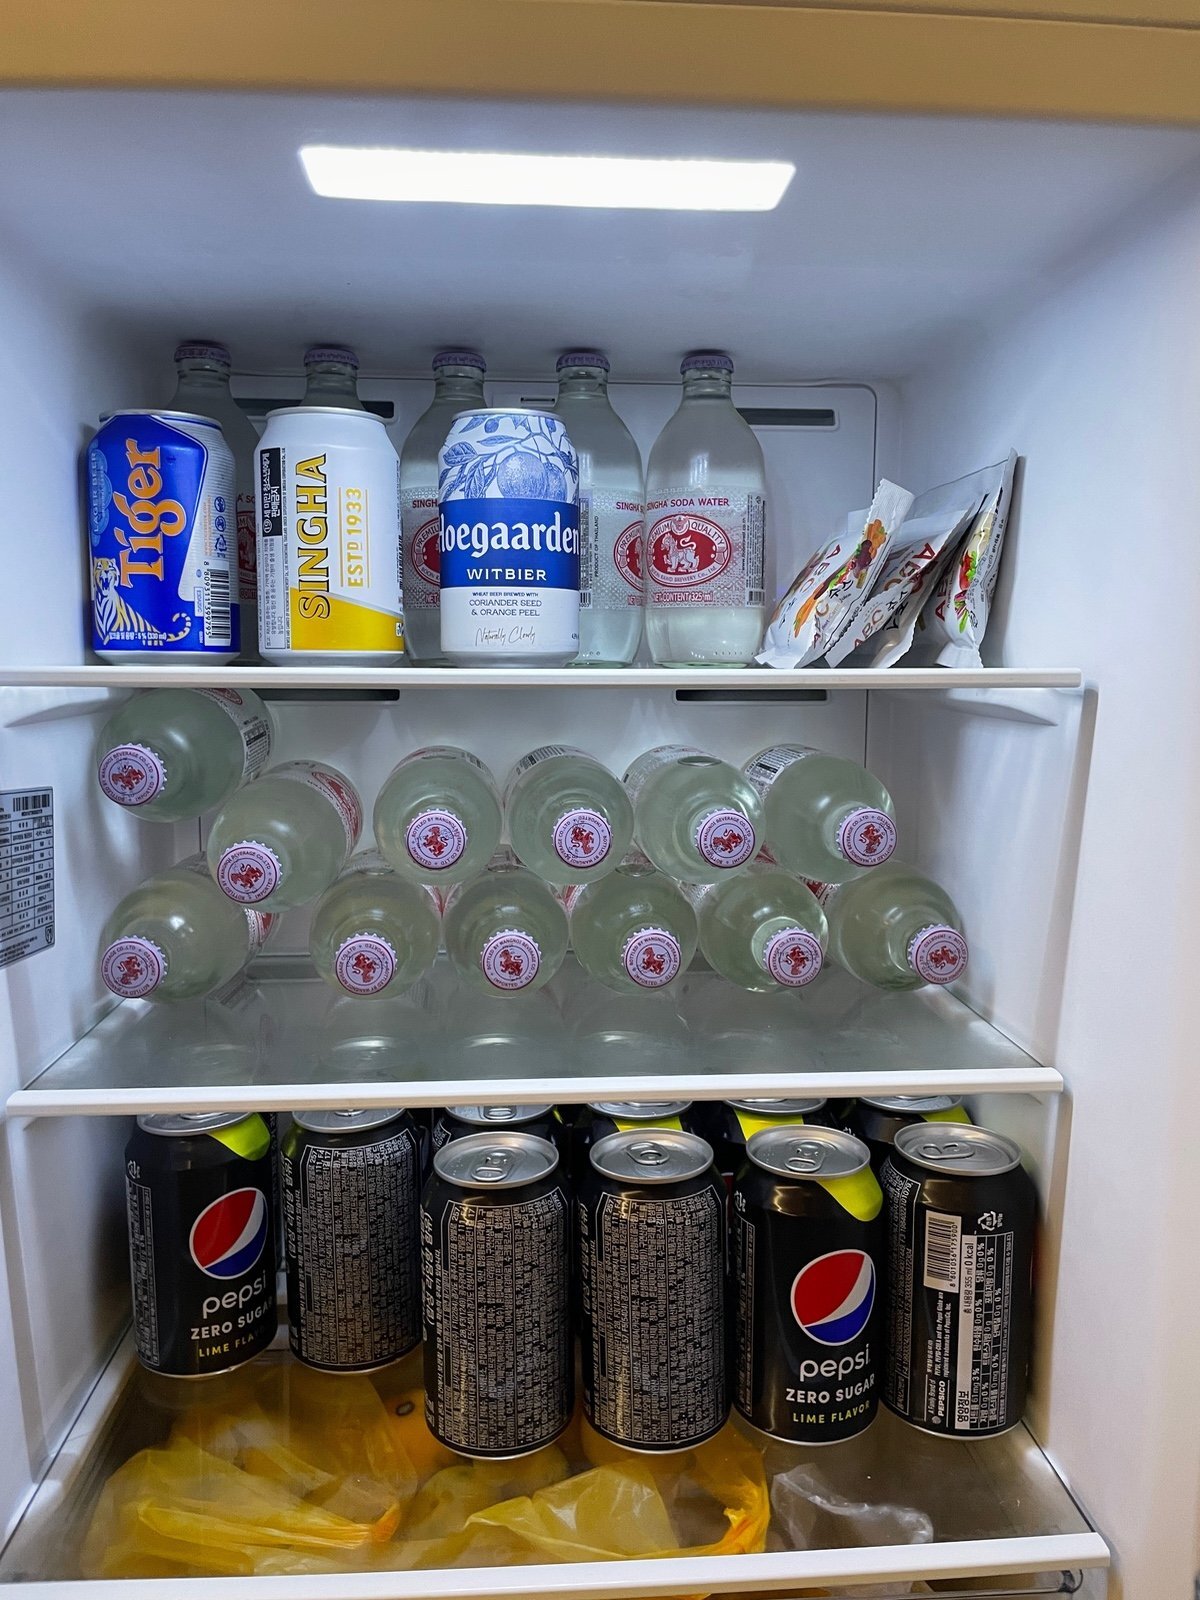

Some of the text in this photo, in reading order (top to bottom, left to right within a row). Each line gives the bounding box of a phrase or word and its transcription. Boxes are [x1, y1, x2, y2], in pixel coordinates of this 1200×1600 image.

[90, 452, 99, 487] BEER
[91, 490, 100, 532] LAGER
[270, 486, 281, 518] 판매금지
[345, 488, 363, 534] 1933
[412, 499, 439, 509] SINGH
[670, 499, 695, 507] SODA
[698, 498, 730, 507] WATER
[113, 438, 187, 588] Tiger
[295, 453, 331, 620] SINGHA
[690, 521, 724, 546] QUALITY
[466, 568, 547, 581] WITBIER
[469, 599, 518, 607] CORIANDER
[690, 592, 703, 602] 325
[519, 609, 540, 617] PEEL
[410, 818, 426, 837] BOTTLED
[598, 835, 607, 856] BOTTLED
[876, 844, 893, 861] BOTTLED
[704, 849, 722, 864] BOTTLED
[224, 886, 244, 900] BOTTLED
[485, 948, 494, 970] BOTTLED
[964, 1242, 974, 1260] kcal
[965, 1276, 973, 1289] 355
[202, 1269, 266, 1319] pepsi
[963, 1290, 972, 1308] 내용량
[190, 1321, 233, 1340] ZERO
[199, 1343, 230, 1357] LIME
[799, 1344, 870, 1382] pepsi
[786, 1374, 875, 1405] ZERO SUGAR
[938, 1380, 946, 1417] PEPSICO
[793, 1400, 870, 1424] LIME FLAVOR
[957, 1390, 970, 1423] 영양정보
